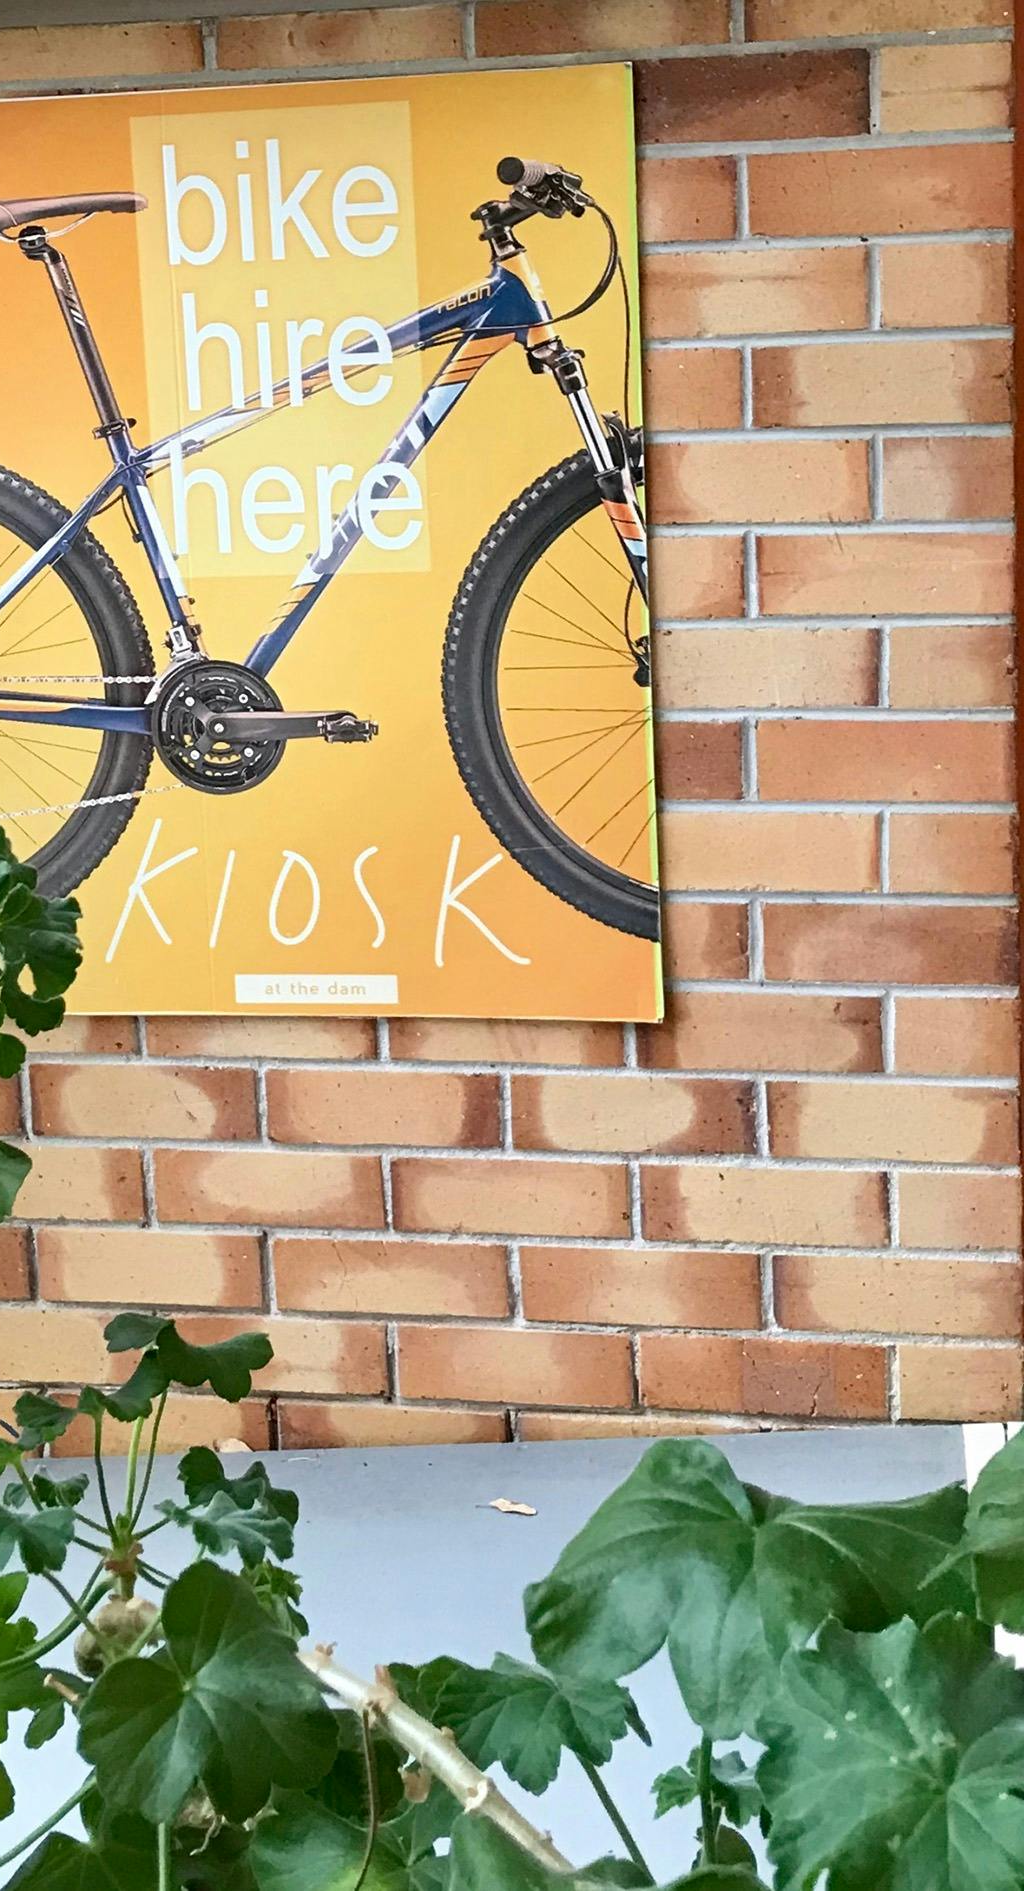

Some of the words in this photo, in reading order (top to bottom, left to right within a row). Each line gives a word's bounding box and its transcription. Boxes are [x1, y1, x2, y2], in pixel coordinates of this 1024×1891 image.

[162, 139, 399, 266] bike
[184, 290, 394, 411] hire
[170, 440, 421, 555] here
[104, 817, 531, 968] KIOSK
[264, 982, 281, 996] at
[290, 981, 320, 996] the
[327, 981, 367, 996] dam
